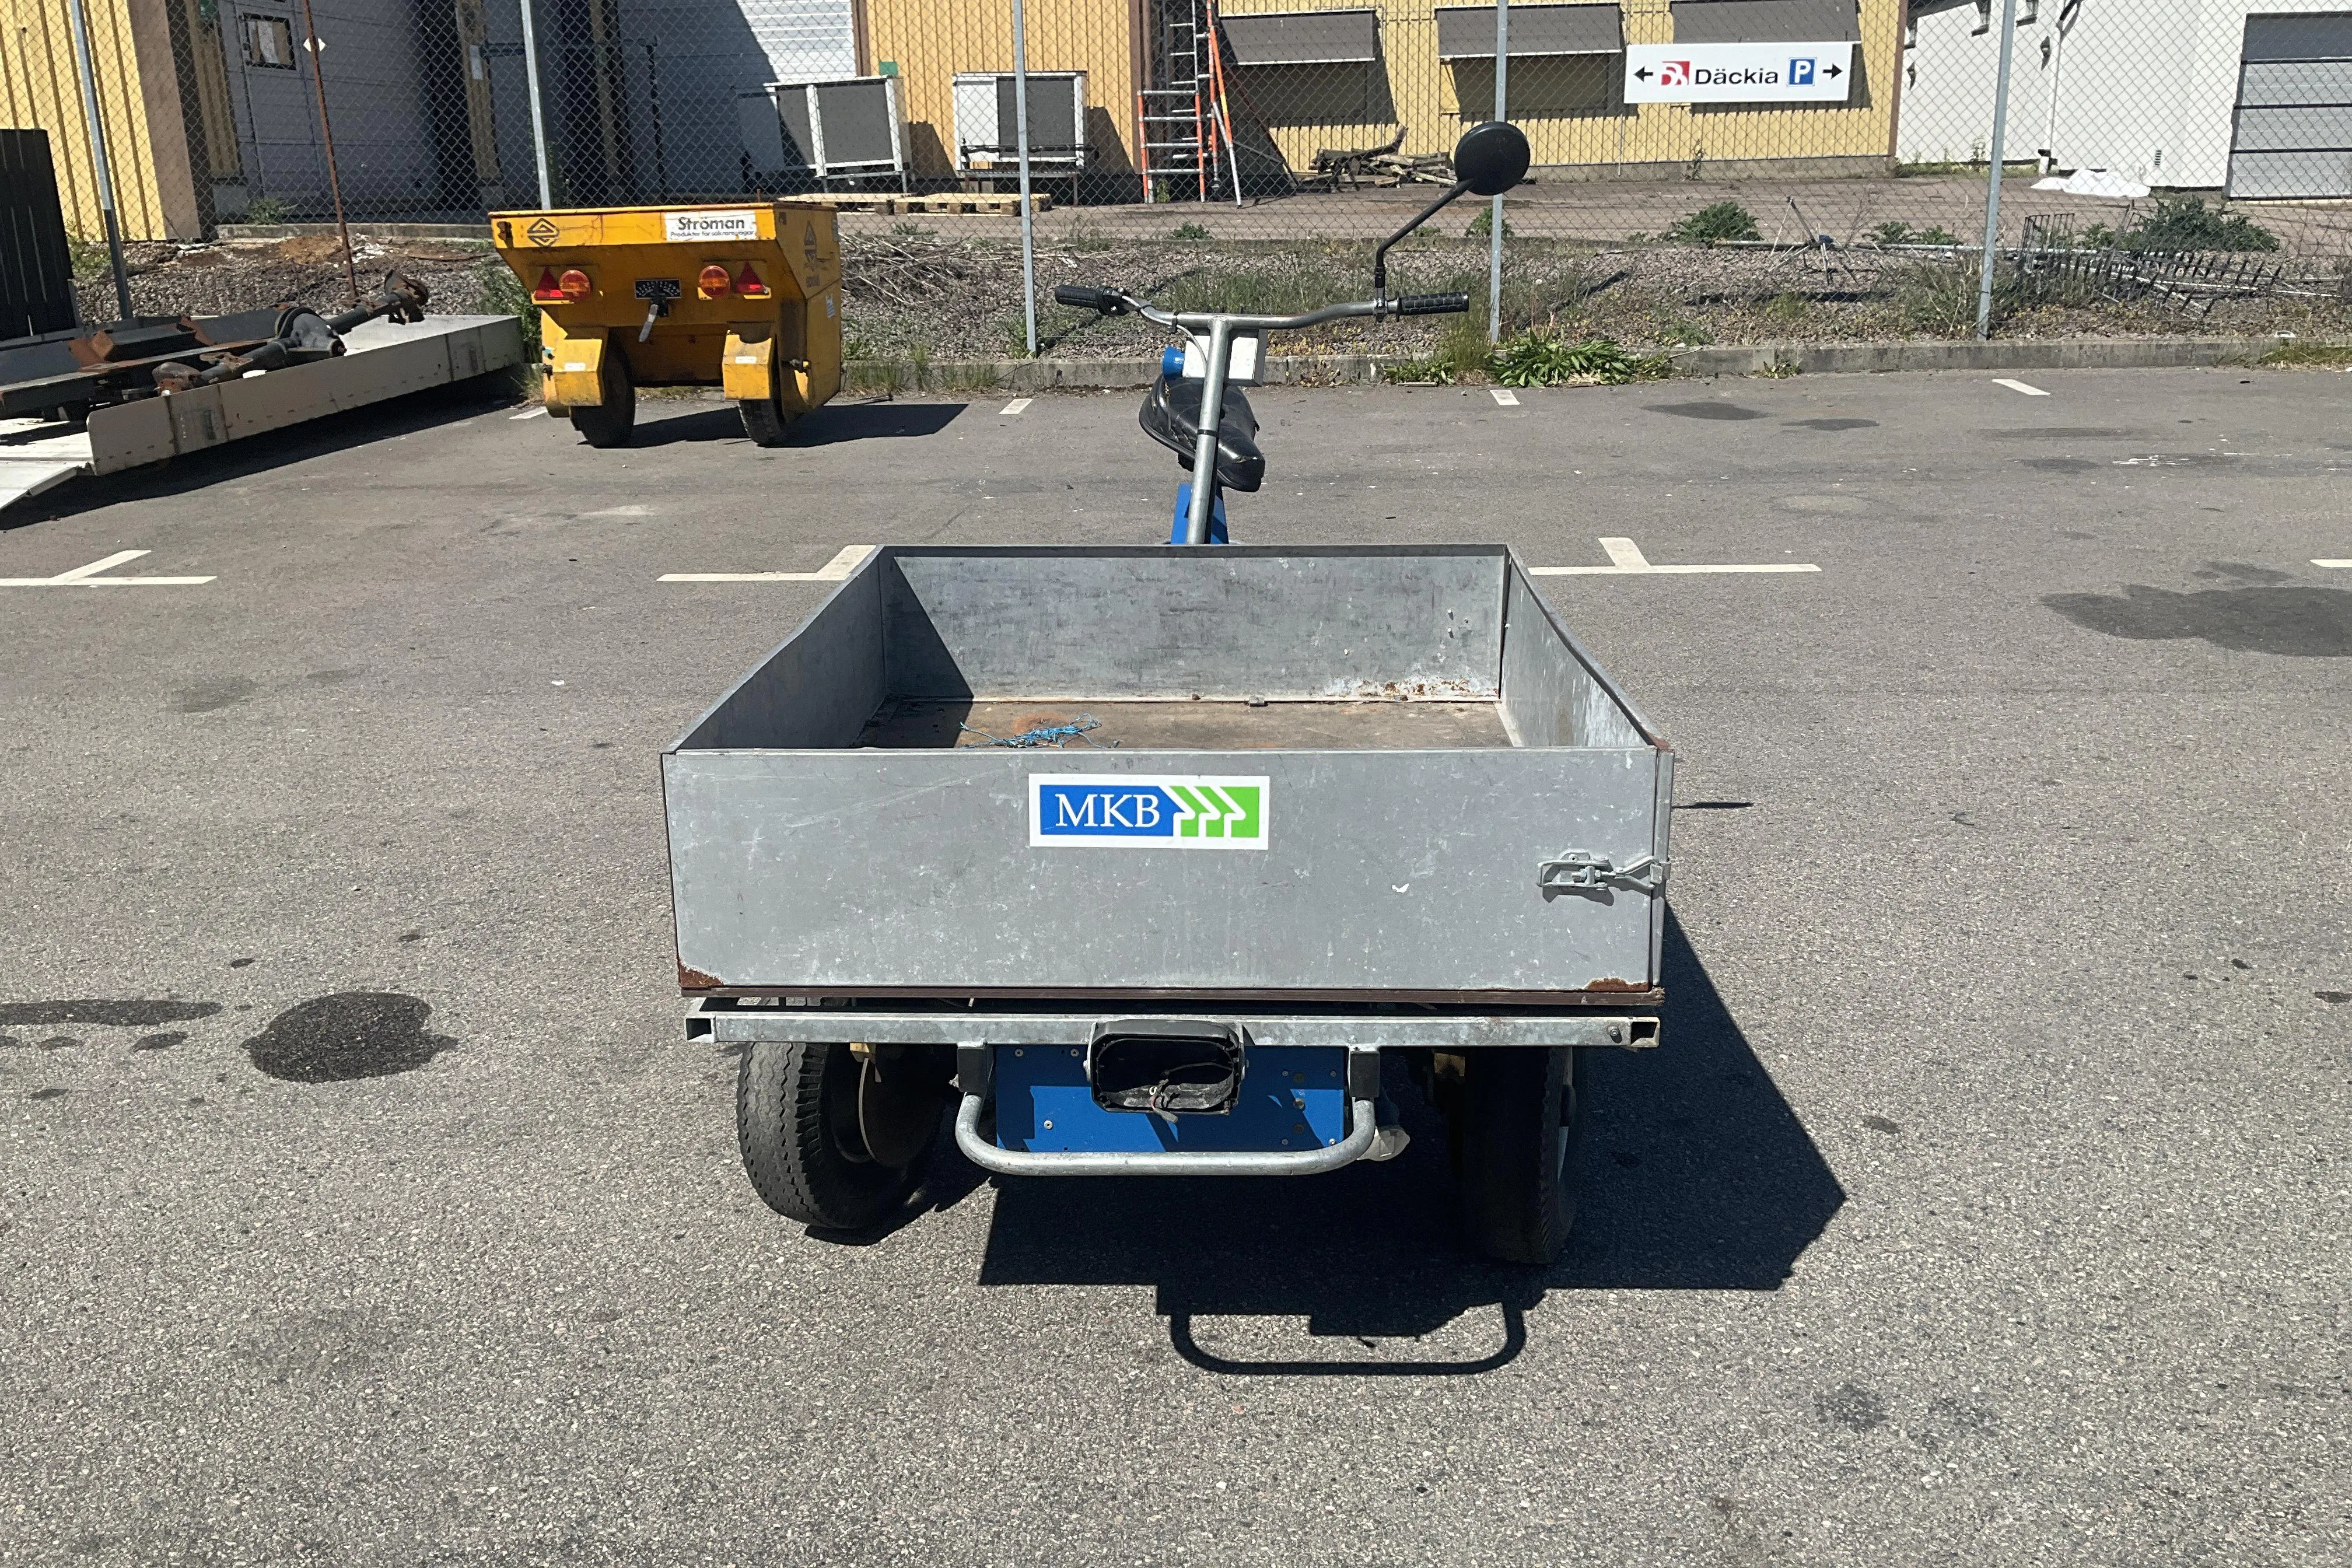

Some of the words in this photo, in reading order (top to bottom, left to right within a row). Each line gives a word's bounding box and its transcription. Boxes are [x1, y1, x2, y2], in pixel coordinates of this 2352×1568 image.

[1695, 68, 1778, 85] Däckia
[1794, 60, 1811, 83] P
[678, 216, 744, 230] Ströman
[1055, 793, 1160, 827] MKB
